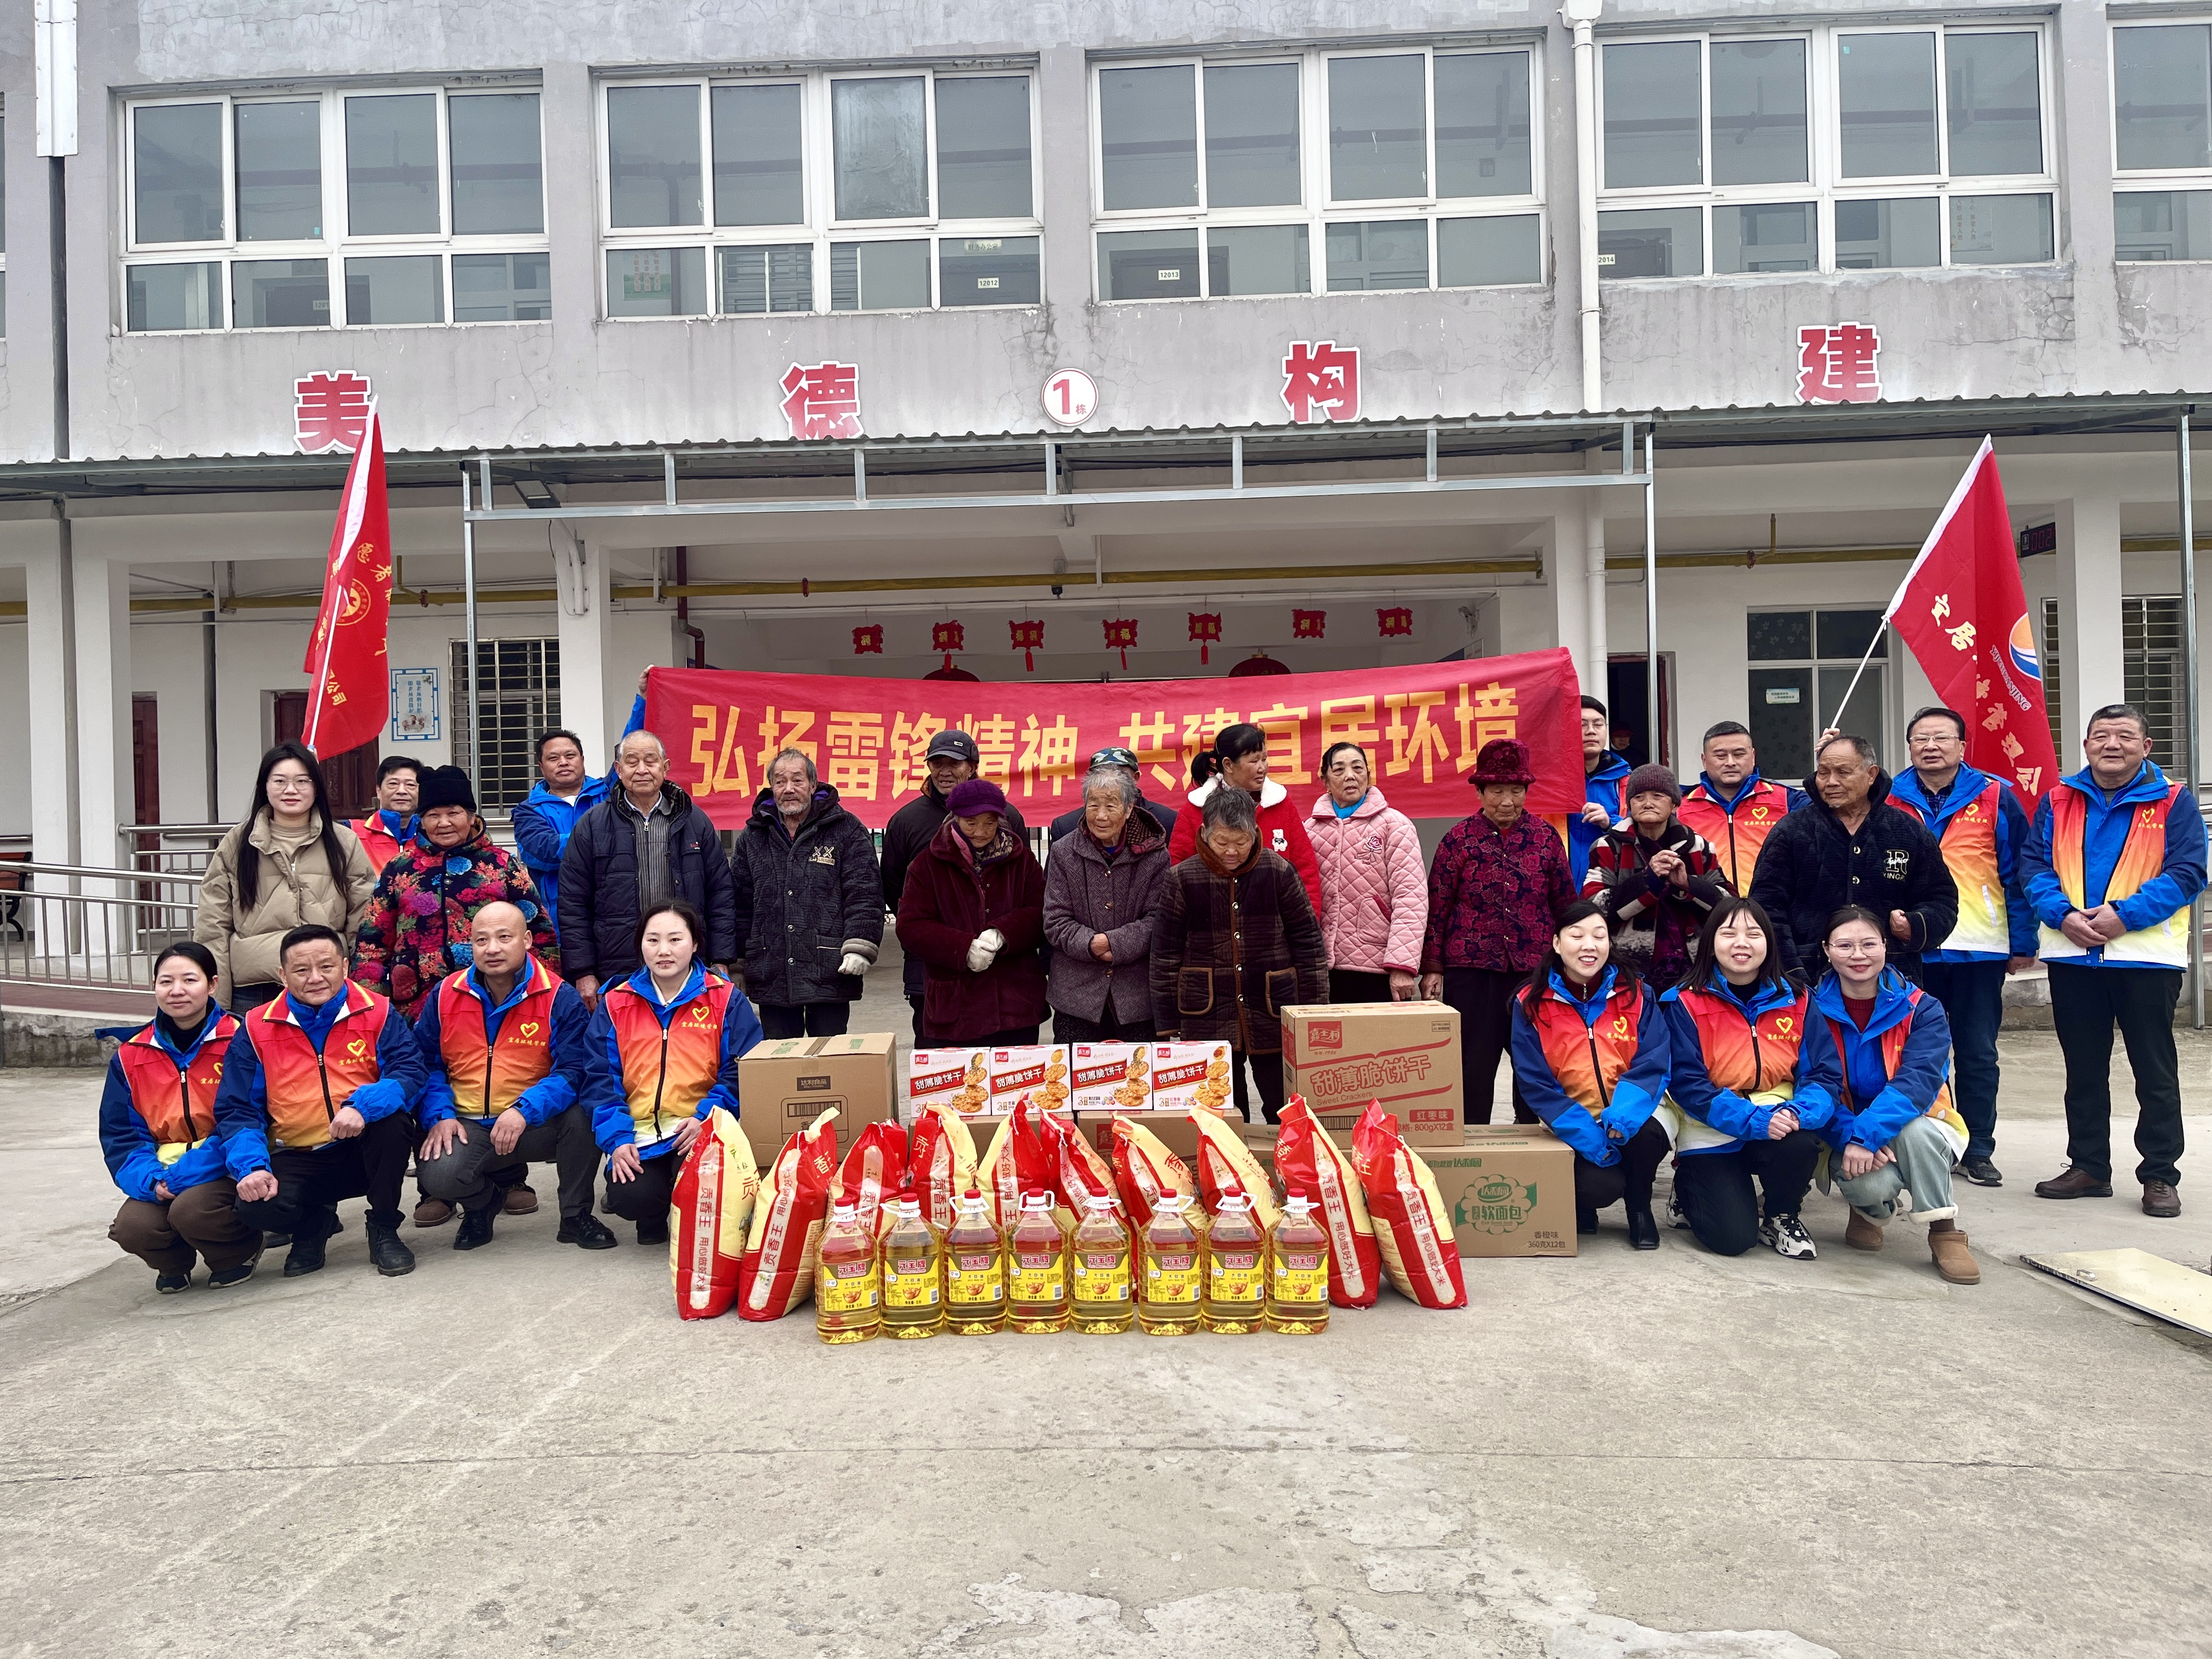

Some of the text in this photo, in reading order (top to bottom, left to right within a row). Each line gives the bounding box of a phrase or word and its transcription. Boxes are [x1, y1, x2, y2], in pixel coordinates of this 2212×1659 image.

[1796, 323, 1882, 404] 建
[1282, 342, 1360, 422] 构
[781, 362, 864, 439] 德
[295, 371, 371, 452] 美
[691, 682, 1519, 801] 弘扬雷锋精神 共建宜居环境
[915, 1071, 962, 1091] 甜薄脆饼干
[996, 1068, 1042, 1088] 甜薄脆饼干
[1077, 1064, 1124, 1083] 甜薄脆饼干
[1158, 1065, 1204, 1084] 甜薄脆饼干
[1310, 1054, 1431, 1097] 甜薄脆饼干
[1317, 1091, 1373, 1106] Sweet Crackers
[1416, 1110, 1448, 1121] 红枣味
[699, 1186, 714, 1228] 贡香王
[1407, 1186, 1427, 1229] 贡香王
[1481, 1205, 1523, 1221] 软面包
[1534, 1231, 1559, 1239] 香橙味
[764, 1223, 783, 1267] 贡香王
[1334, 1221, 1356, 1280] 用心做好大米
[695, 1236, 709, 1293] 用心做好大米
[838, 1262, 866, 1274] 元宝牌
[898, 1260, 926, 1269] 元宝牌
[961, 1256, 989, 1266] 元宝牌
[1022, 1254, 1049, 1264] 元宝牌
[1087, 1254, 1116, 1264] 元宝牌
[1162, 1255, 1190, 1266] 元宝牌
[1225, 1255, 1254, 1265] 元宝牌
[1289, 1255, 1317, 1265] 元宝牌
[1420, 1232, 1447, 1287] 用心做好大米
